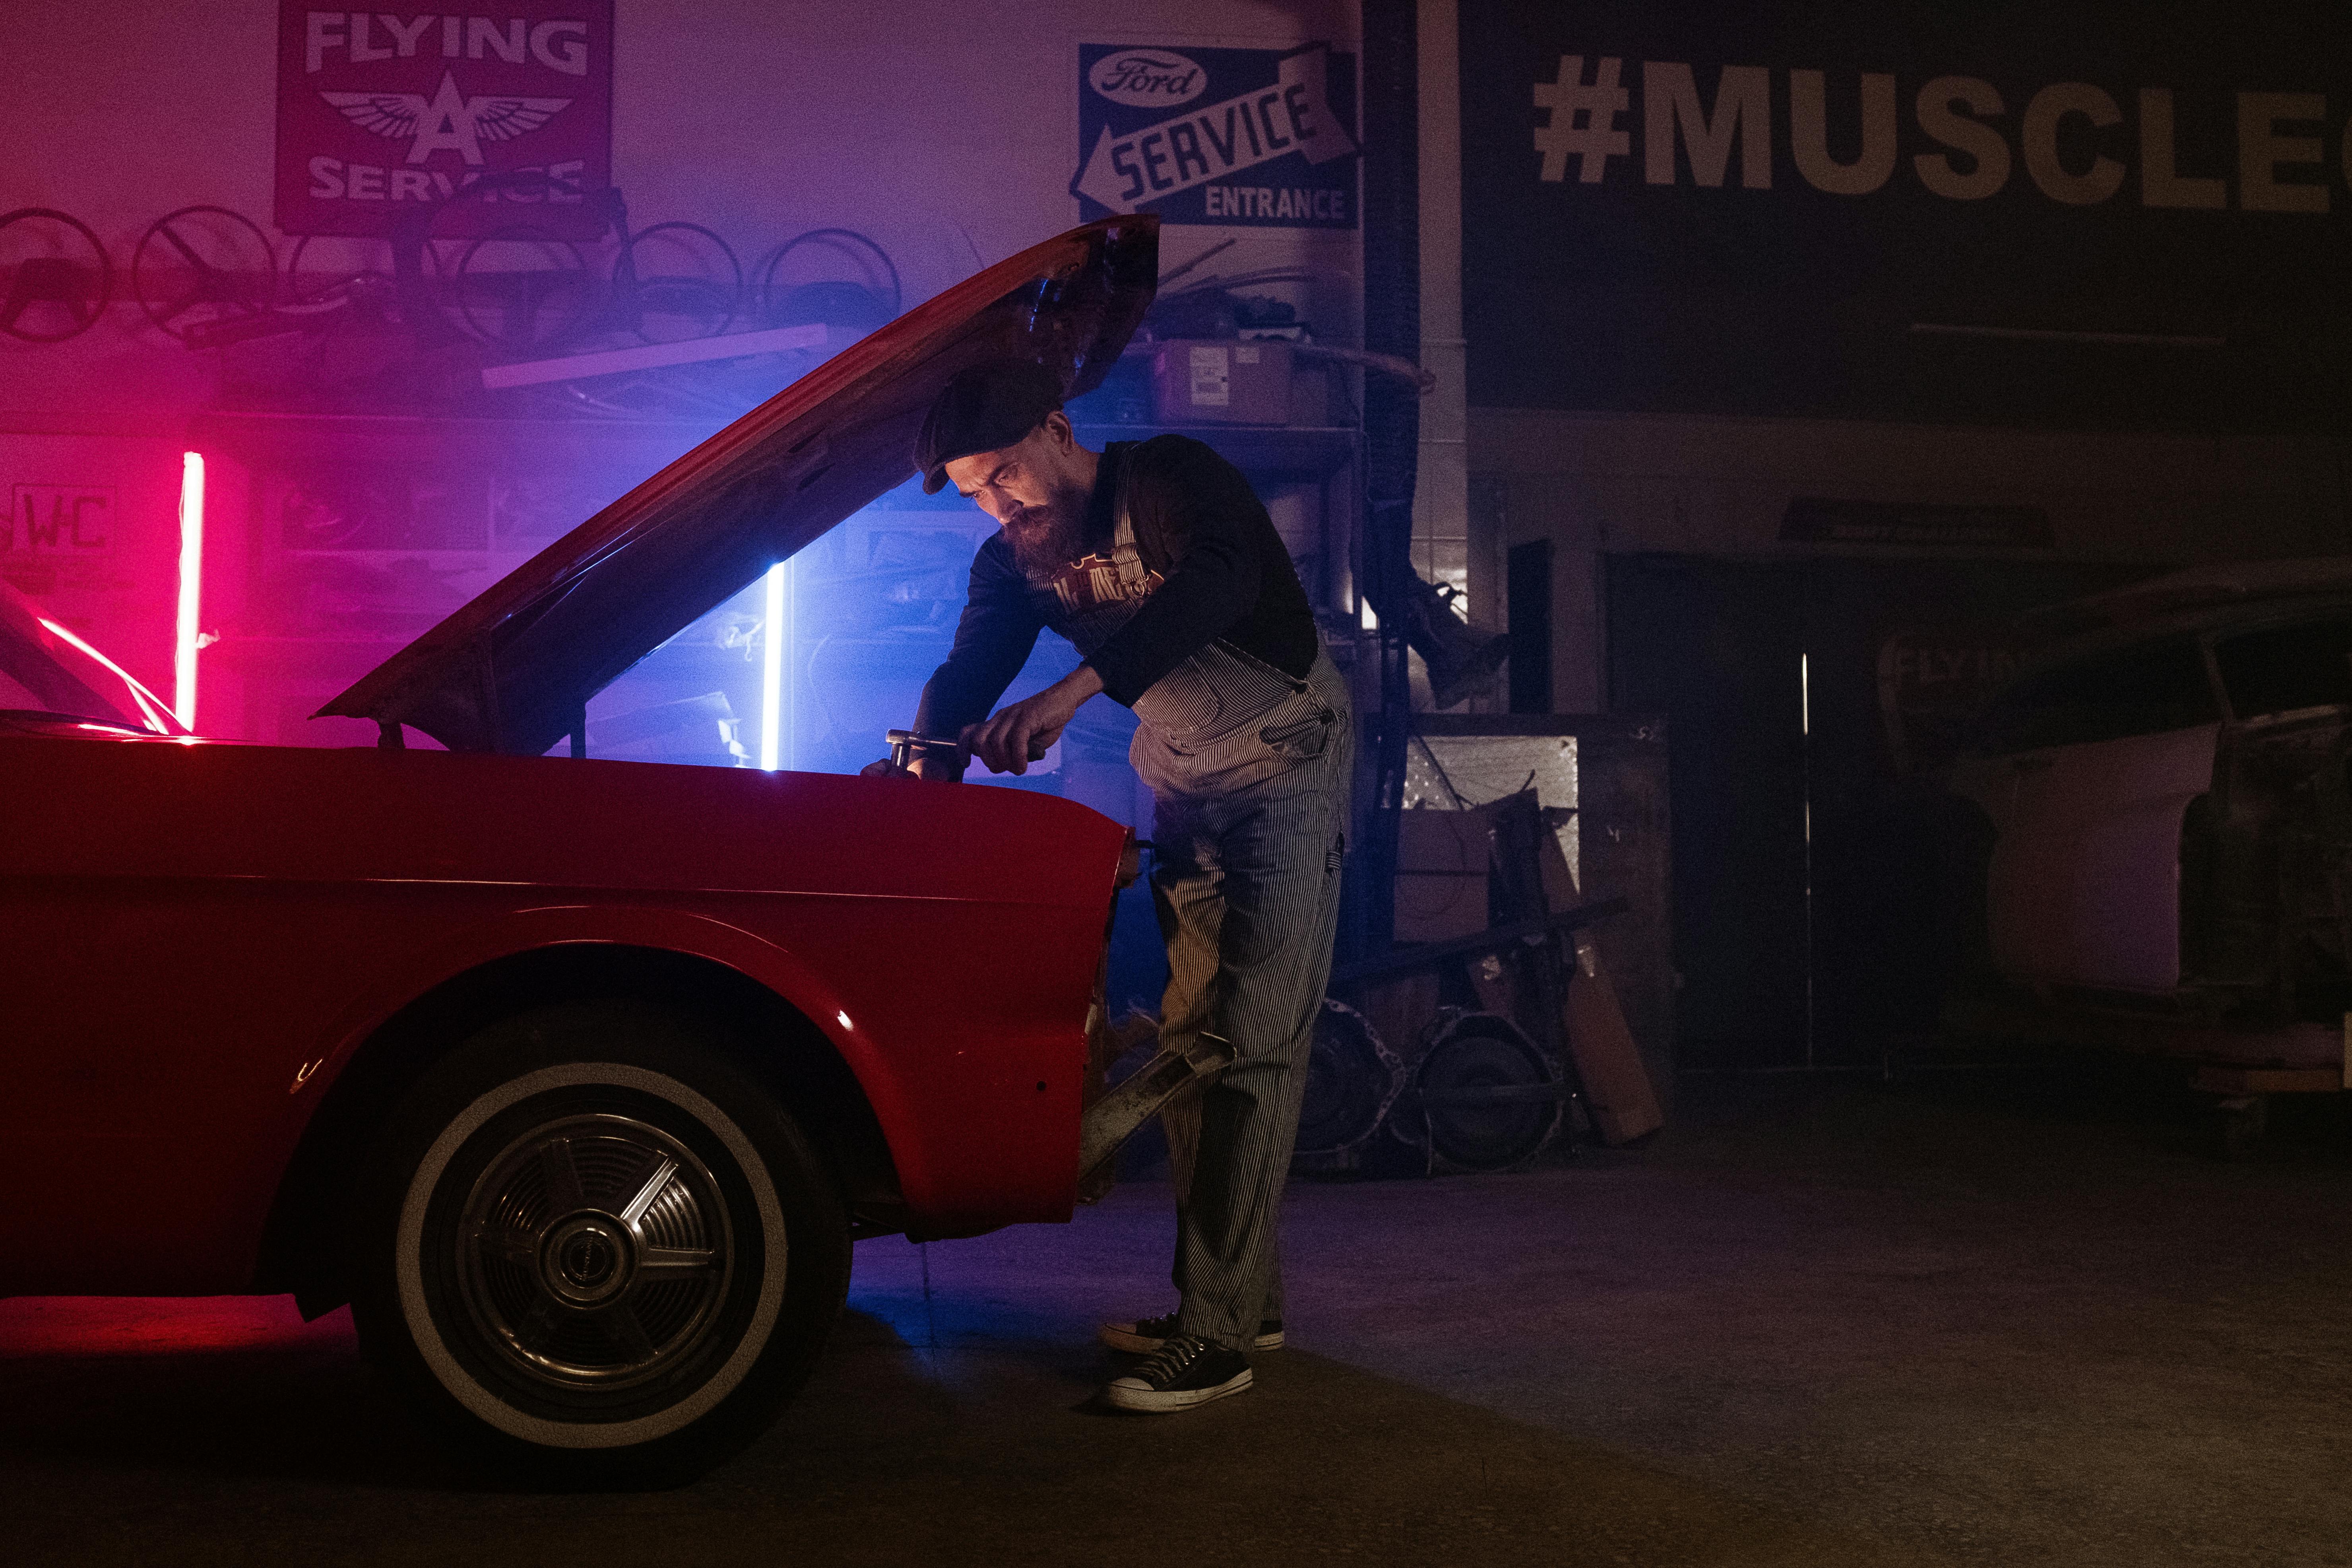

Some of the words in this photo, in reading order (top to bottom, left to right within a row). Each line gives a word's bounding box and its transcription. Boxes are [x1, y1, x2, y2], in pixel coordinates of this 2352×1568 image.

[306, 11, 588, 76] FLYING
[1101, 57, 1197, 95] Ford
[1111, 82, 1317, 201] SERVICE
[1533, 54, 2352, 214] #MUSCLE
[1205, 184, 1347, 220] ENTRANCE
